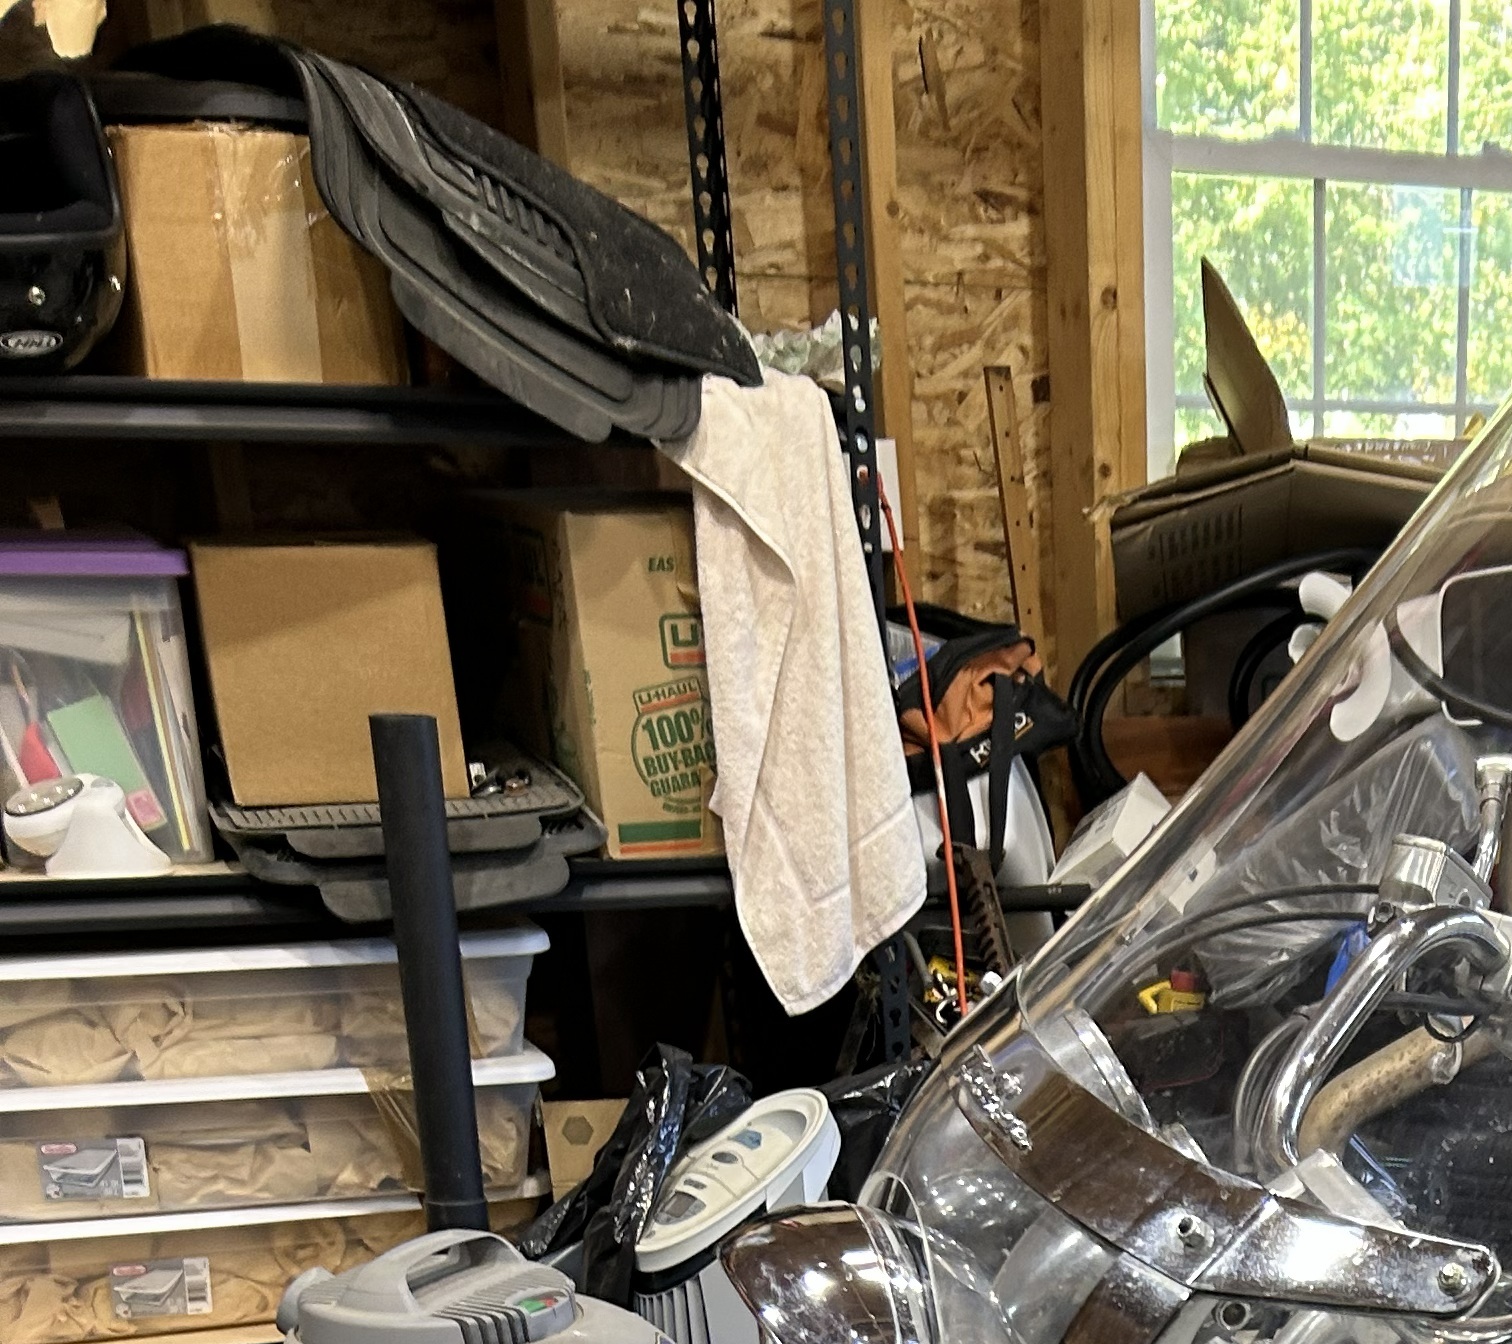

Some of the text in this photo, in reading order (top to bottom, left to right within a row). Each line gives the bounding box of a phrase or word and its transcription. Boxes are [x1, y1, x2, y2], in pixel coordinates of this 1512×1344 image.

[648, 556, 675, 572] EAS
[642, 706, 714, 751] 100%
[642, 741, 716, 778] BUY-BAC
[651, 770, 701, 798] GUARA
